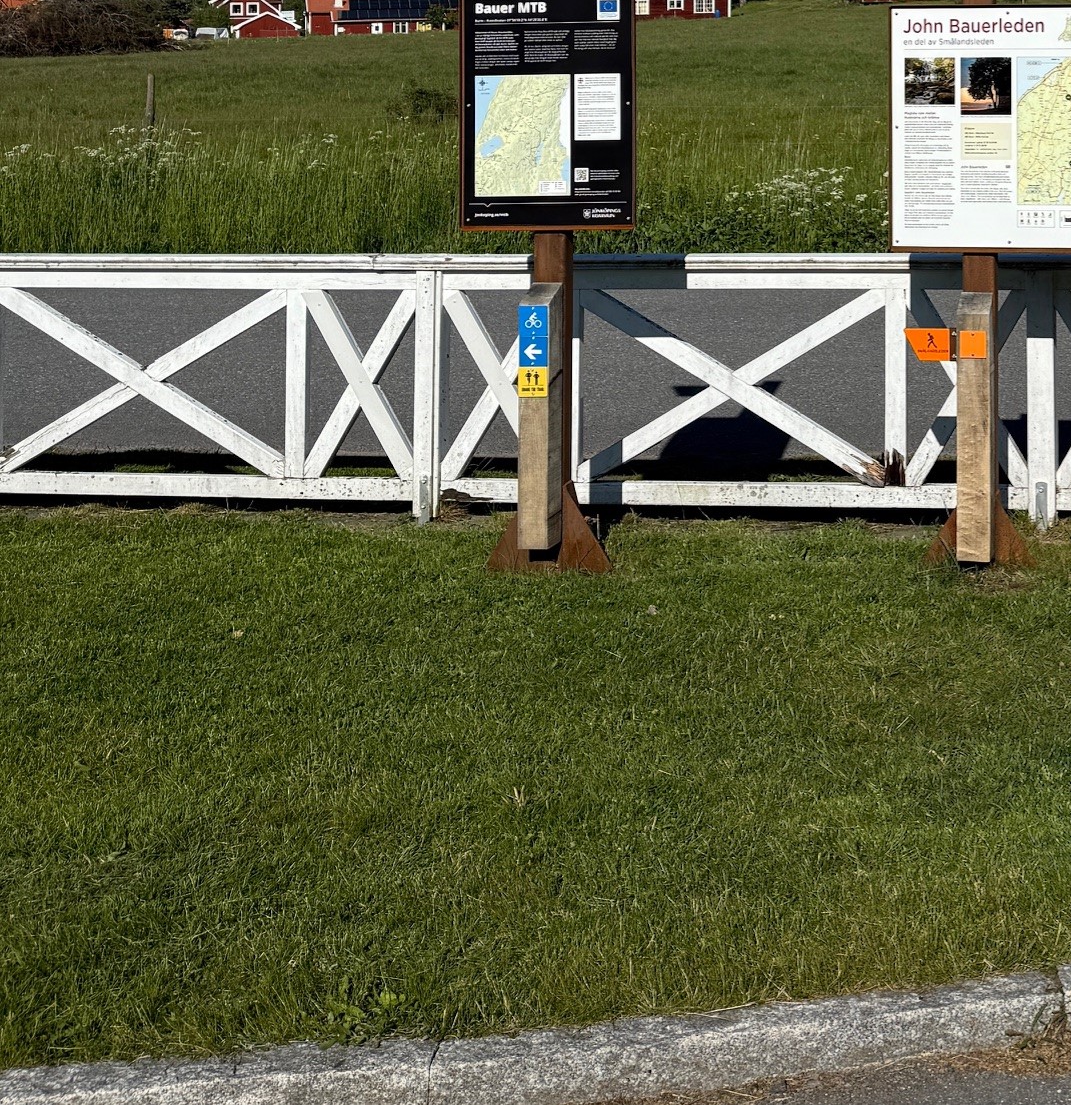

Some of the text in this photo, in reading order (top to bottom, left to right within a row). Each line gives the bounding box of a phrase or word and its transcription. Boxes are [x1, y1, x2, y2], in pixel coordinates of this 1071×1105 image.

[474, 1, 547, 15] Bauer MTB
[904, 18, 1045, 33] John Bauerleden
